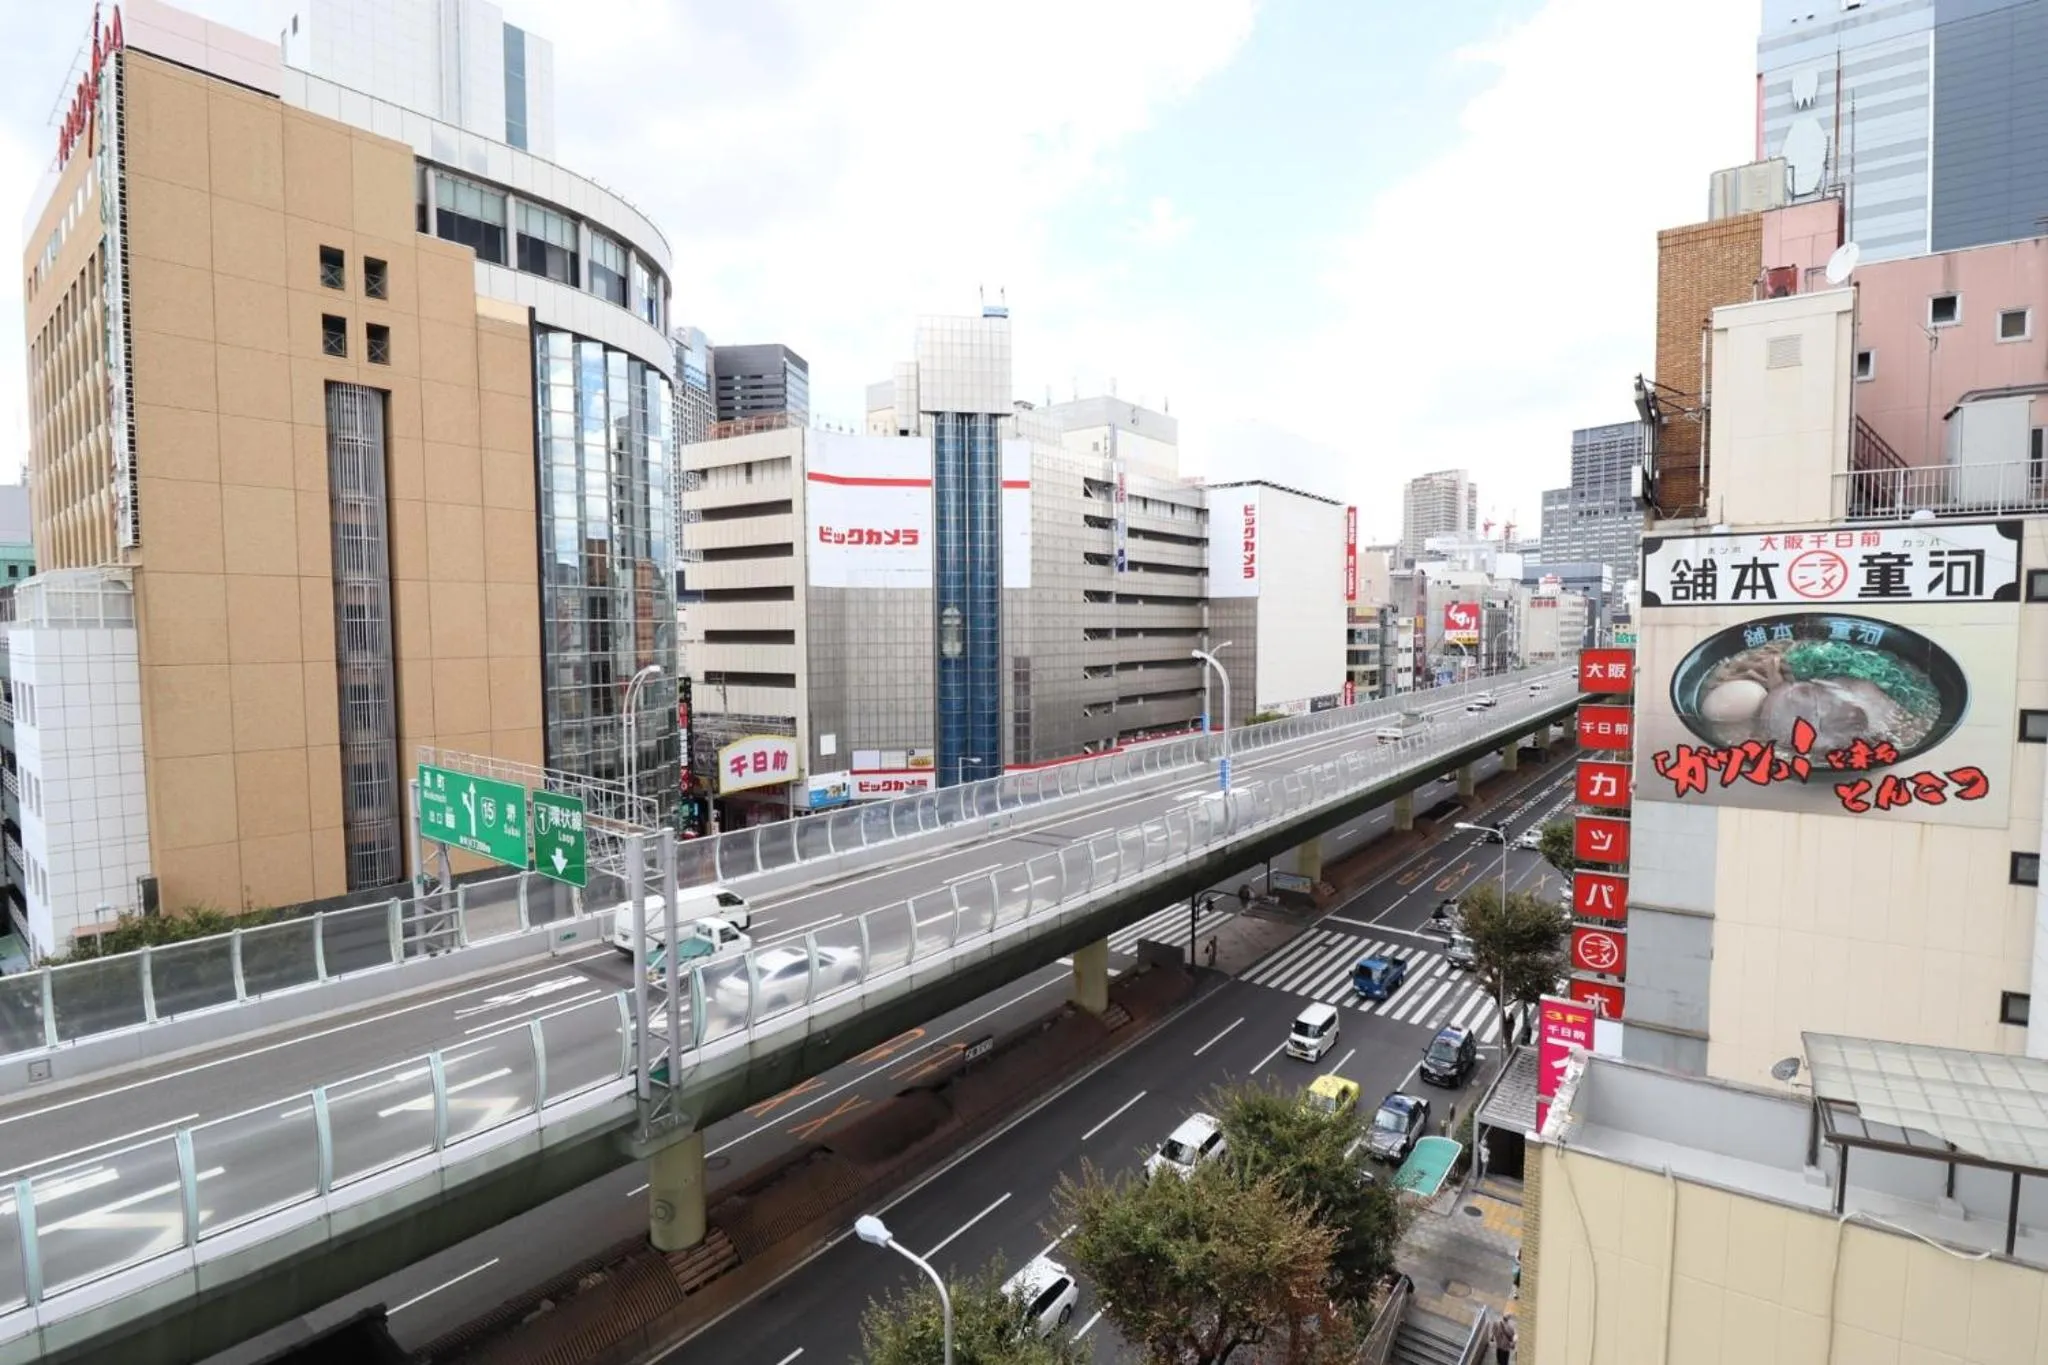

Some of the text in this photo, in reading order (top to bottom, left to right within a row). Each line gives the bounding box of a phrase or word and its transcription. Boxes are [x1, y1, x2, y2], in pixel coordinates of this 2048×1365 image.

[819, 526, 919, 546] ビックカメラ
[1243, 504, 1255, 580] ビックカメラ
[1759, 531, 1882, 551] 大阪千日前
[1585, 662, 1627, 680] 大阪
[1581, 721, 1629, 735] 千日前
[730, 750, 788, 778] 千日前
[1834, 766, 1989, 813] とんこつ
[1547, 1024, 1586, 1041] 千日前
